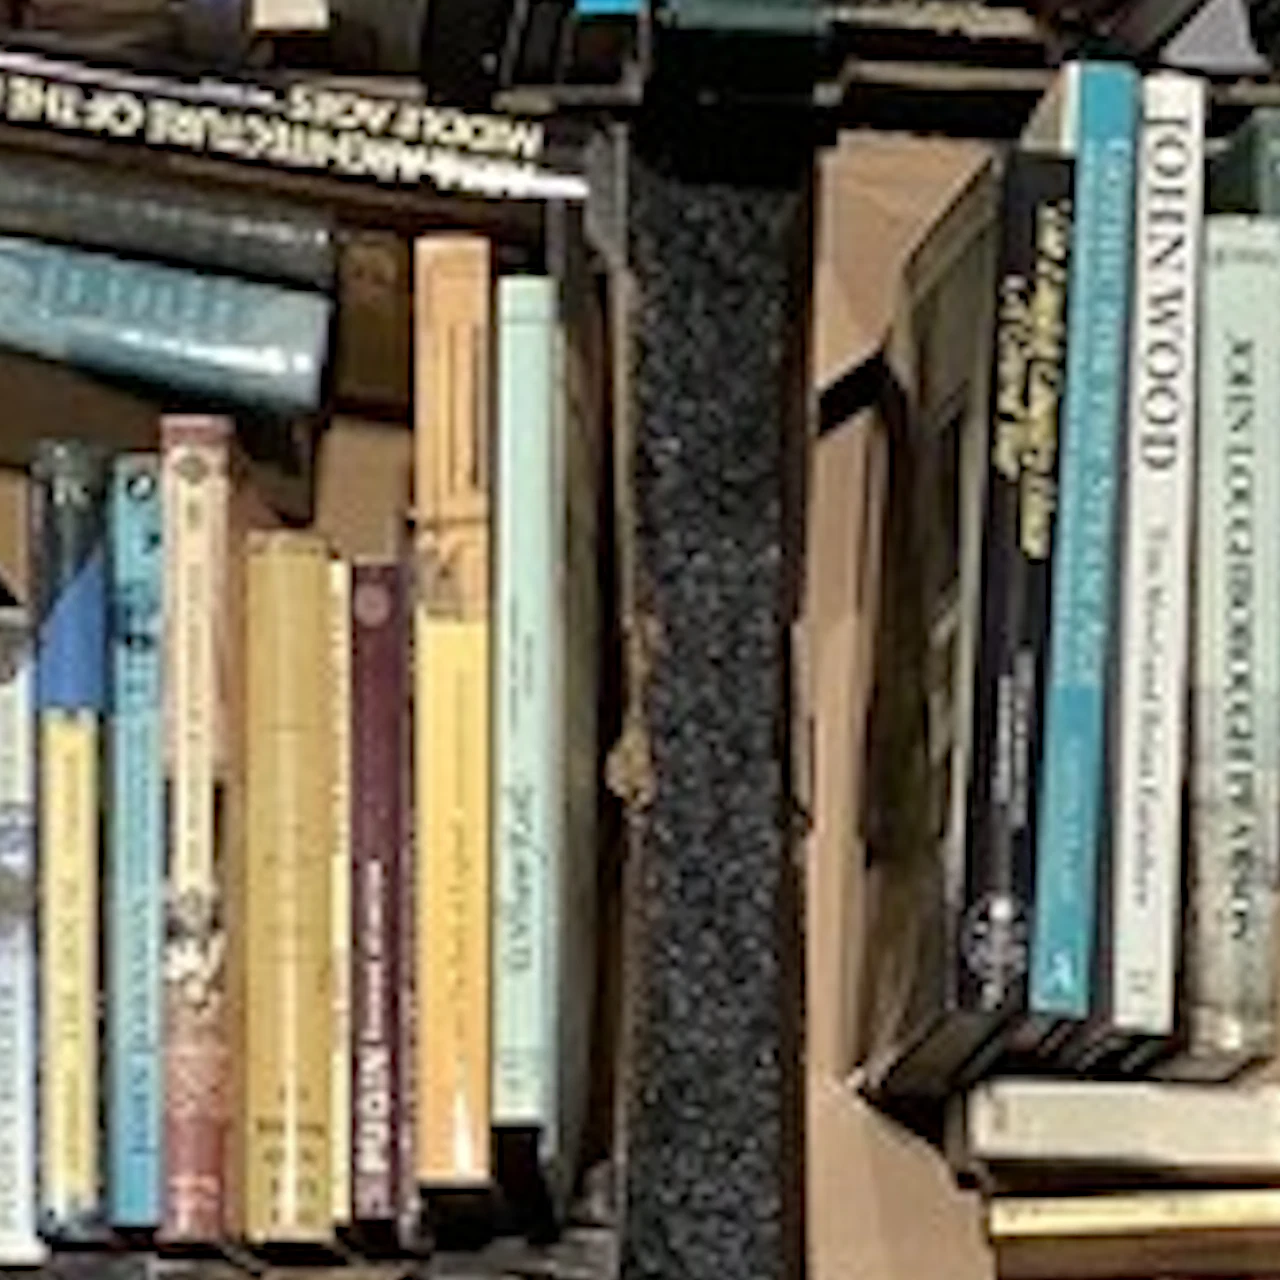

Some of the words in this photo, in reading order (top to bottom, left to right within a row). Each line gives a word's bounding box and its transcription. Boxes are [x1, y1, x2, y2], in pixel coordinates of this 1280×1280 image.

[7, 77, 79, 129] THE
[83, 91, 143, 136] OF
[151, 99, 423, 183] ARCHITECTURE
[289, 84, 396, 133] AGES
[401, 108, 544, 157] MIDDLE
[1099, 136, 1131, 287] GOTHIC
[1138, 119, 1191, 275] JOHN
[1137, 282, 1187, 472] WOOD
[1225, 332, 1256, 435] JOHN
[1225, 444, 1256, 764] LOUGHBOROUGH
[357, 1044, 389, 1171] PUGIN
